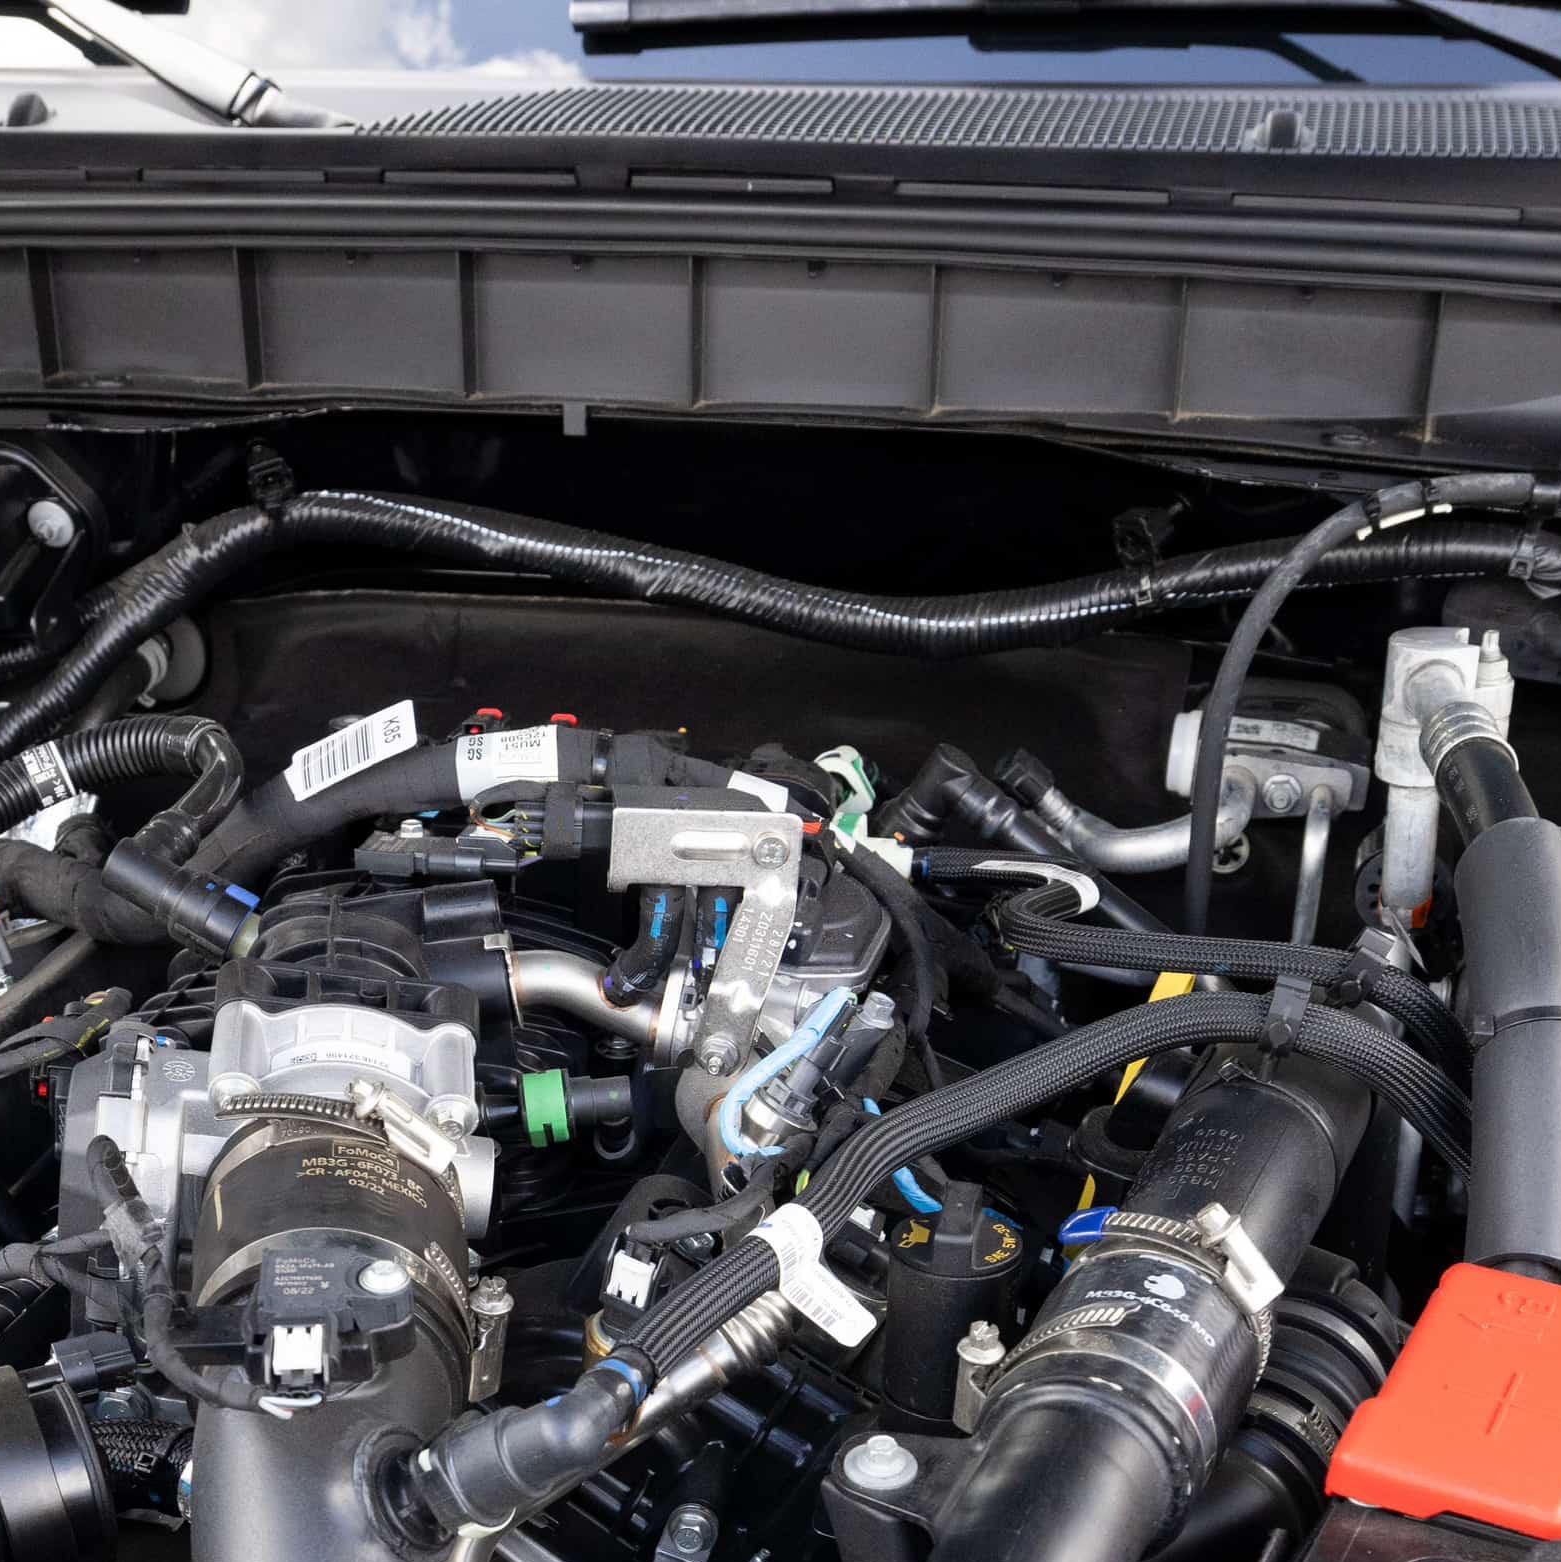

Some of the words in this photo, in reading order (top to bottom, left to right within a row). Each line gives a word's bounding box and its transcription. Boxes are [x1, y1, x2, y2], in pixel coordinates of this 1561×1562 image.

[382, 716, 402, 744] K85
[469, 737, 484, 747] SG
[468, 749, 482, 760] SG
[337, 1146, 395, 1168] FoMoCo
[348, 1178, 386, 1197] 02/22
[381, 1179, 428, 1209] MEXICO
[992, 1223, 1017, 1249] 5W-30
[983, 1249, 1011, 1263] SAE
